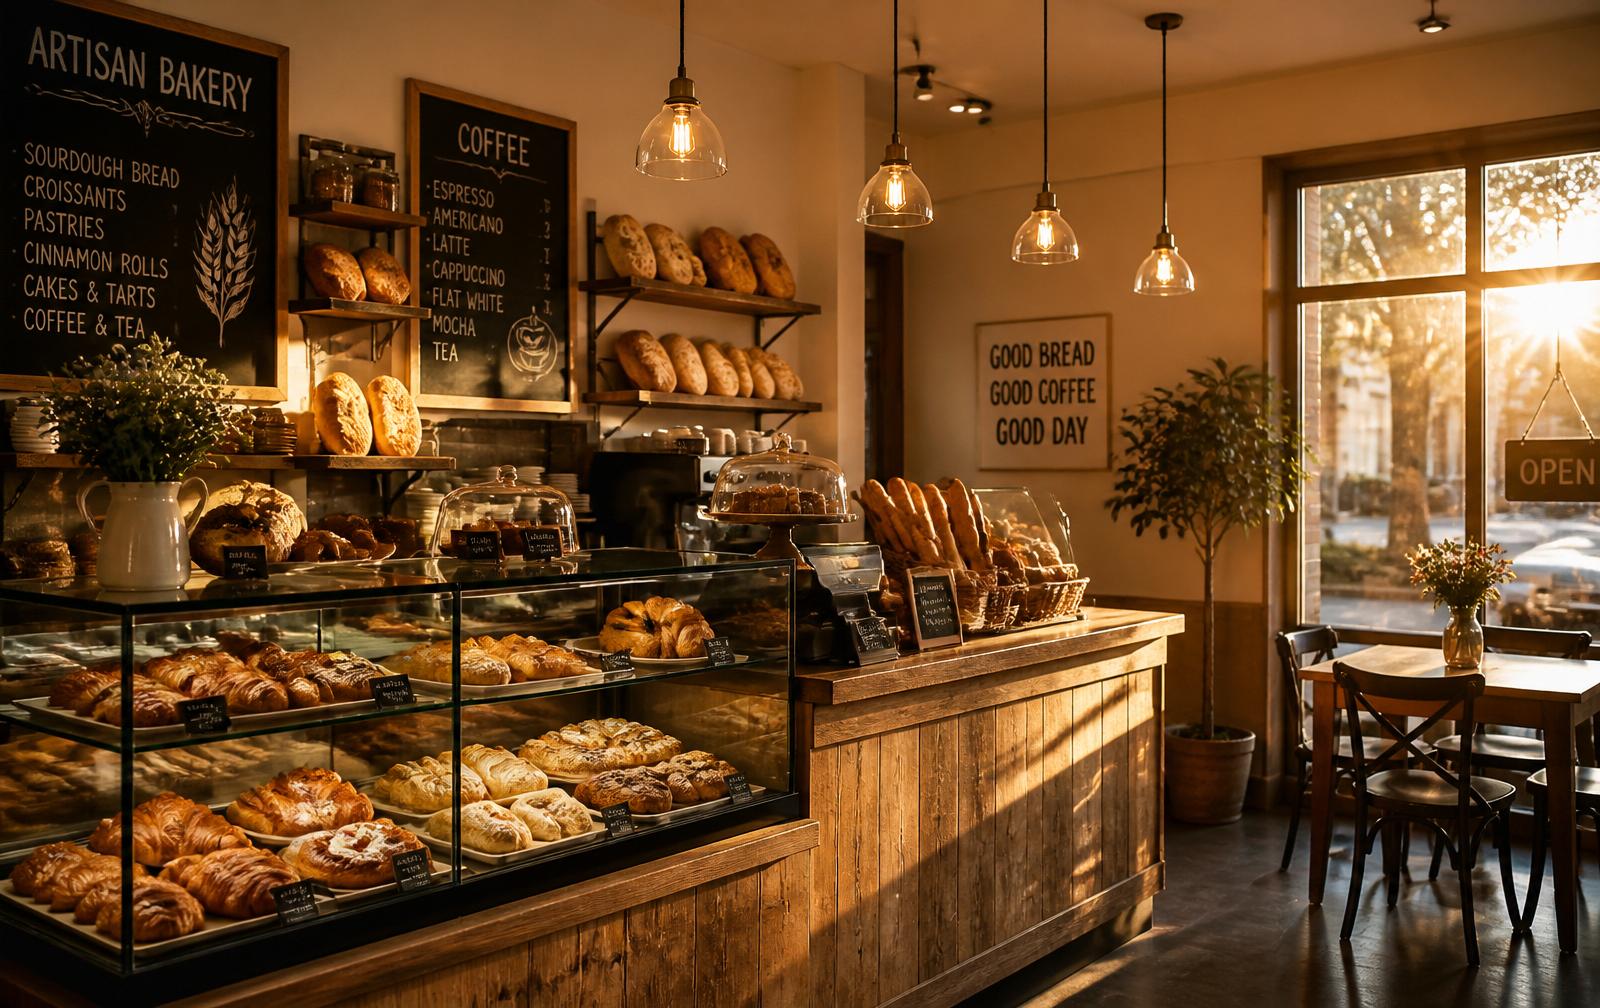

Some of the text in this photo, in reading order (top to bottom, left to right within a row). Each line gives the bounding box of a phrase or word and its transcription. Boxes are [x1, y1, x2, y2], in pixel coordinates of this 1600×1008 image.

[28, 26, 252, 112] ARTISAN BAKERY
[458, 123, 530, 167] COFFEE
[24, 142, 180, 189] SOURDOUGH BREAD
[24, 175, 127, 212] CROISSANTS
[433, 179, 494, 208] ESPRESSO
[24, 207, 105, 240] PASTRIES
[433, 207, 504, 235] AMERICANO
[433, 233, 471, 256] LATTE
[24, 241, 169, 279] CINNAMON ROLLS
[432, 260, 506, 288] CAPPUCCINO
[24, 274, 156, 309] CAKES & TARTS
[432, 287, 504, 313] FLAT WHITE
[24, 307, 145, 339] COFFEE & TEA
[432, 315, 476, 337] MOCHA
[432, 341, 459, 362] TEA
[990, 340, 1095, 370] GOOD BREAD
[990, 378, 1096, 406] GOOD COFFEE
[996, 416, 1088, 445] GOOD DAY
[1520, 458, 1595, 485] OPEN
